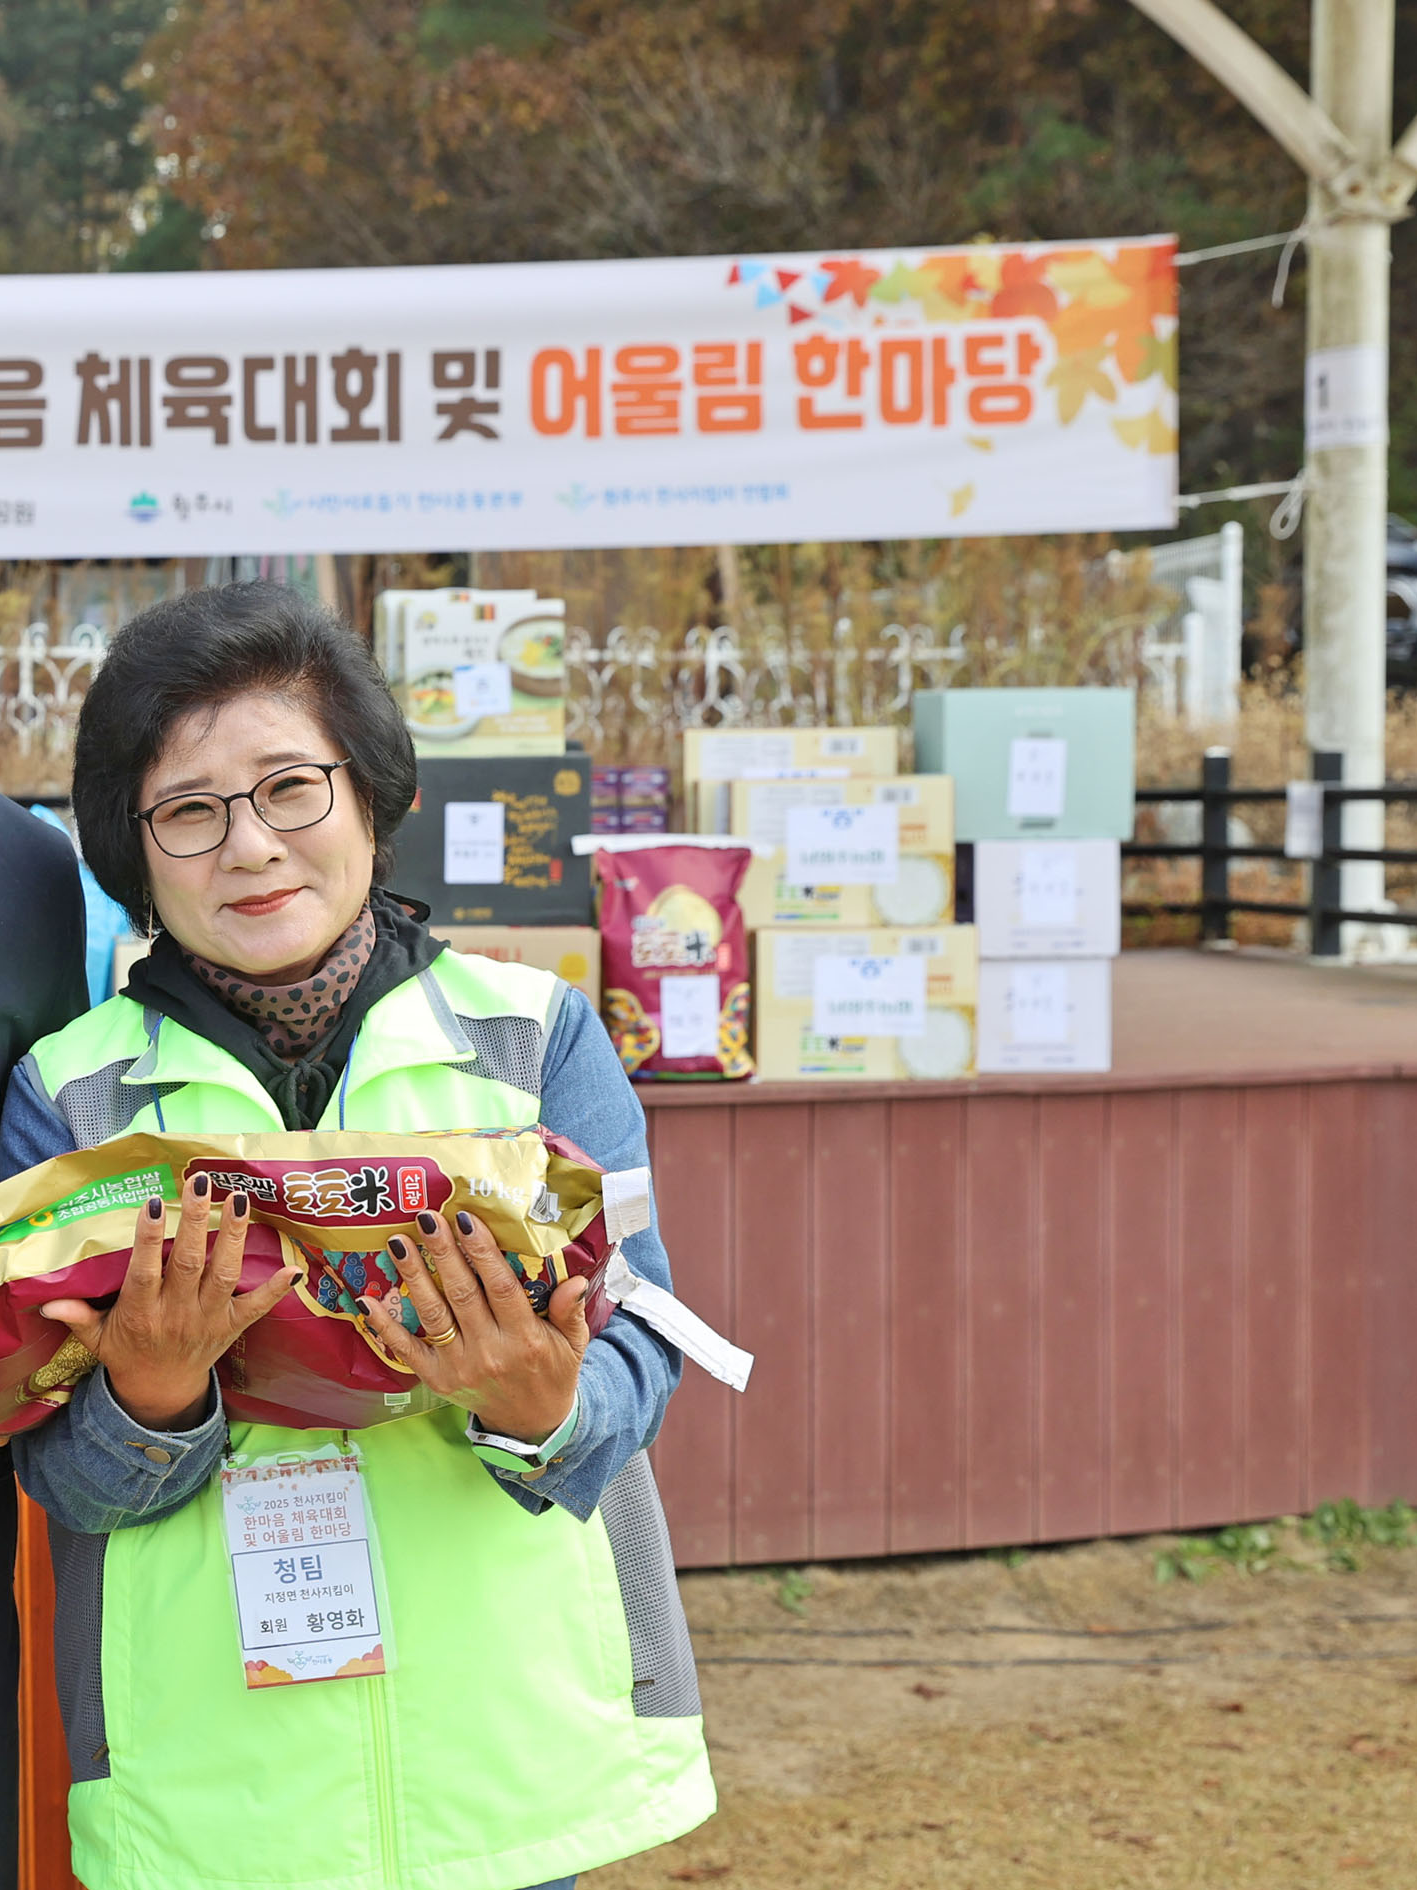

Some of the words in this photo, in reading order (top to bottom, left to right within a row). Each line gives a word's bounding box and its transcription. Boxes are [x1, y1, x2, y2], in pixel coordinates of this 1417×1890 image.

[75, 347, 401, 448] 체육대회
[431, 348, 502, 441] 및
[530, 341, 764, 438] 어울림
[794, 331, 1043, 431] 한마당
[209, 1171, 278, 1202] 원주쌀
[404, 1173, 424, 1207] 삼광
[264, 1498, 290, 1511] 2025
[294, 1491, 347, 1507] 천사지킴이
[243, 1512, 286, 1531] 한마음
[291, 1506, 347, 1525] 체육대회
[243, 1532, 257, 1547] 및
[263, 1527, 304, 1545] 어울림
[310, 1522, 351, 1539] 한마당
[273, 1554, 324, 1584] 청팀
[265, 1590, 297, 1603] 지정면
[300, 1584, 354, 1600] 천사지킴이
[260, 1618, 288, 1634] 회원
[306, 1608, 365, 1633] 황영화
